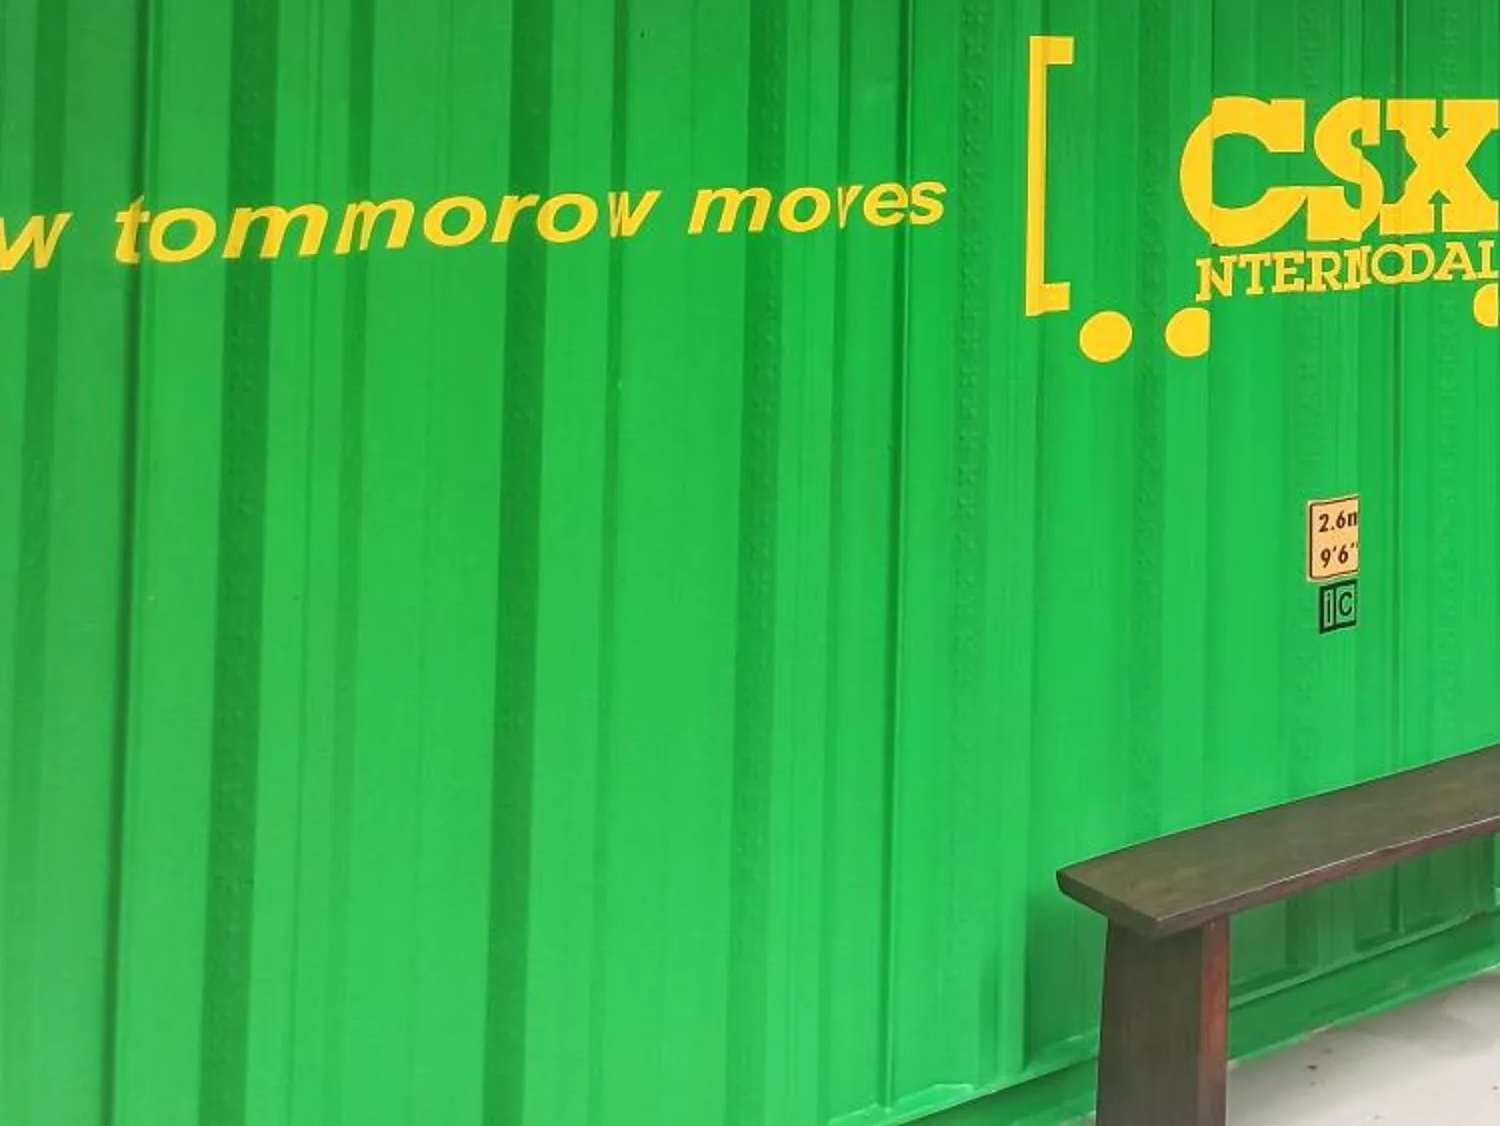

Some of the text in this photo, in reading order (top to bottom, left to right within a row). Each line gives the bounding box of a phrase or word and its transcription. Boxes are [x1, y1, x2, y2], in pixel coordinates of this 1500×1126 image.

[115, 190, 662, 264] tommorow
[688, 181, 948, 235] moves
[1179, 96, 1500, 248] CSX
